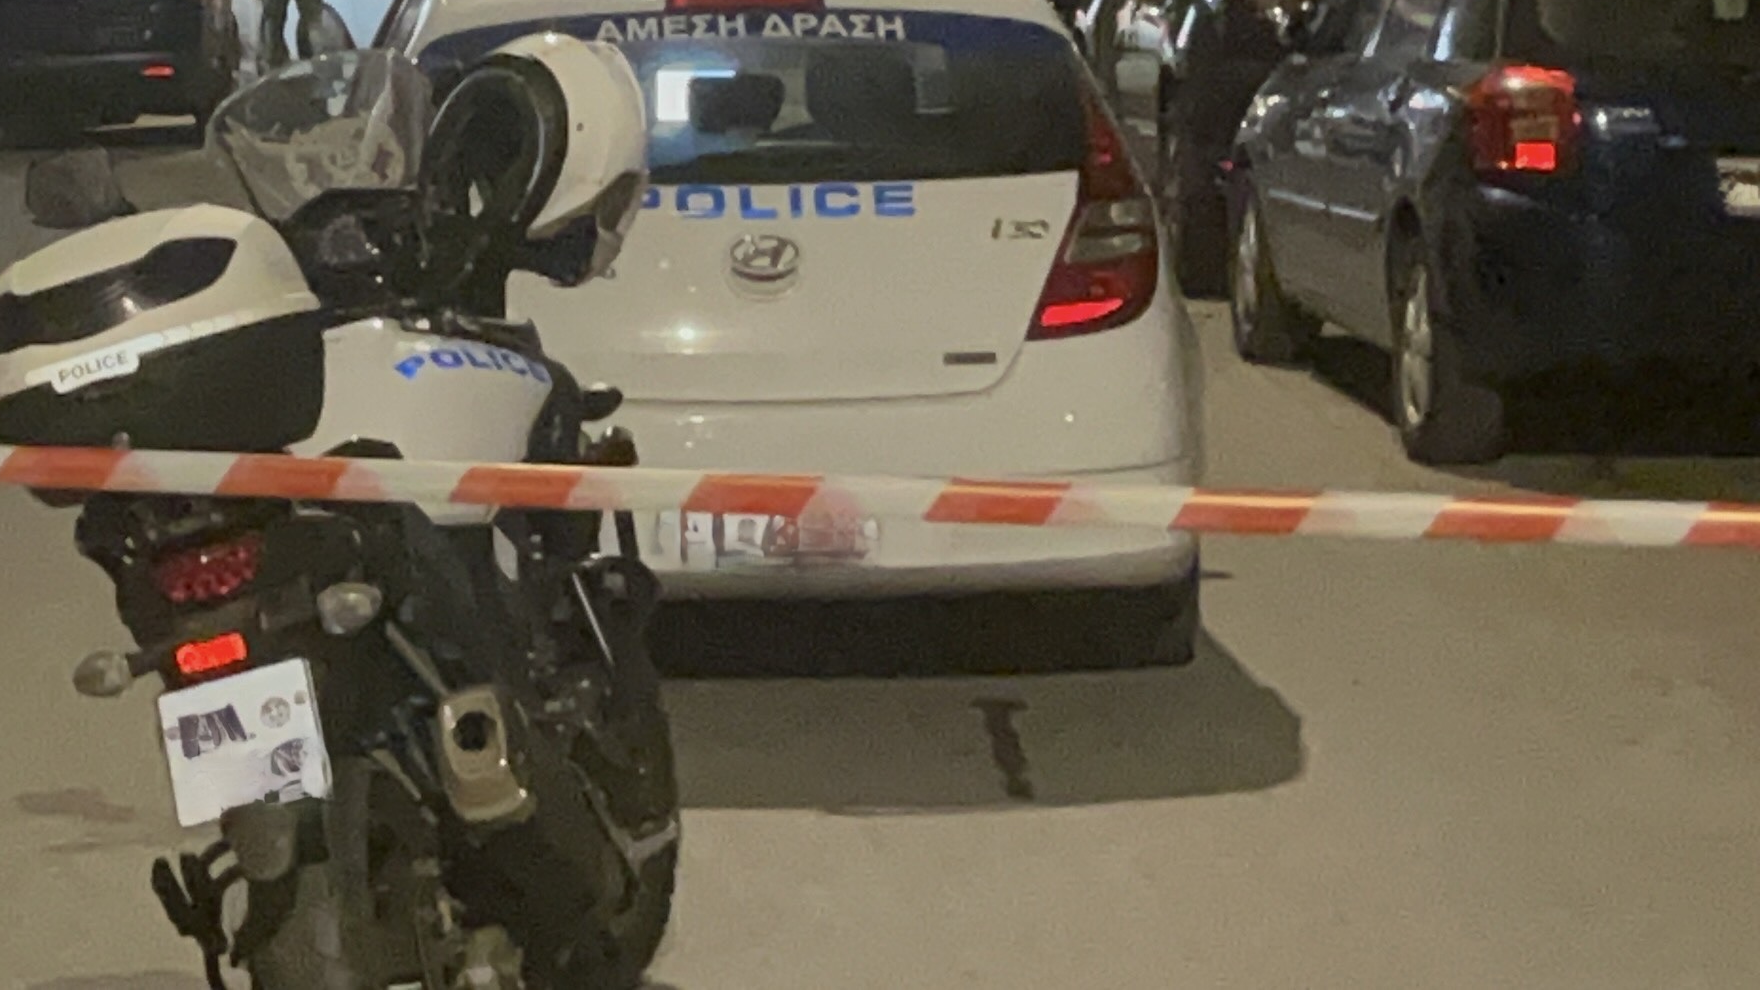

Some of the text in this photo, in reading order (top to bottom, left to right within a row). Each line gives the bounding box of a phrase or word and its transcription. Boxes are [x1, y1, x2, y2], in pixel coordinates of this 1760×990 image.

[596, 12, 905, 42] ΑΜΕΣΗ ΔΡΑΣΗ
[58, 350, 128, 383] POLICE
